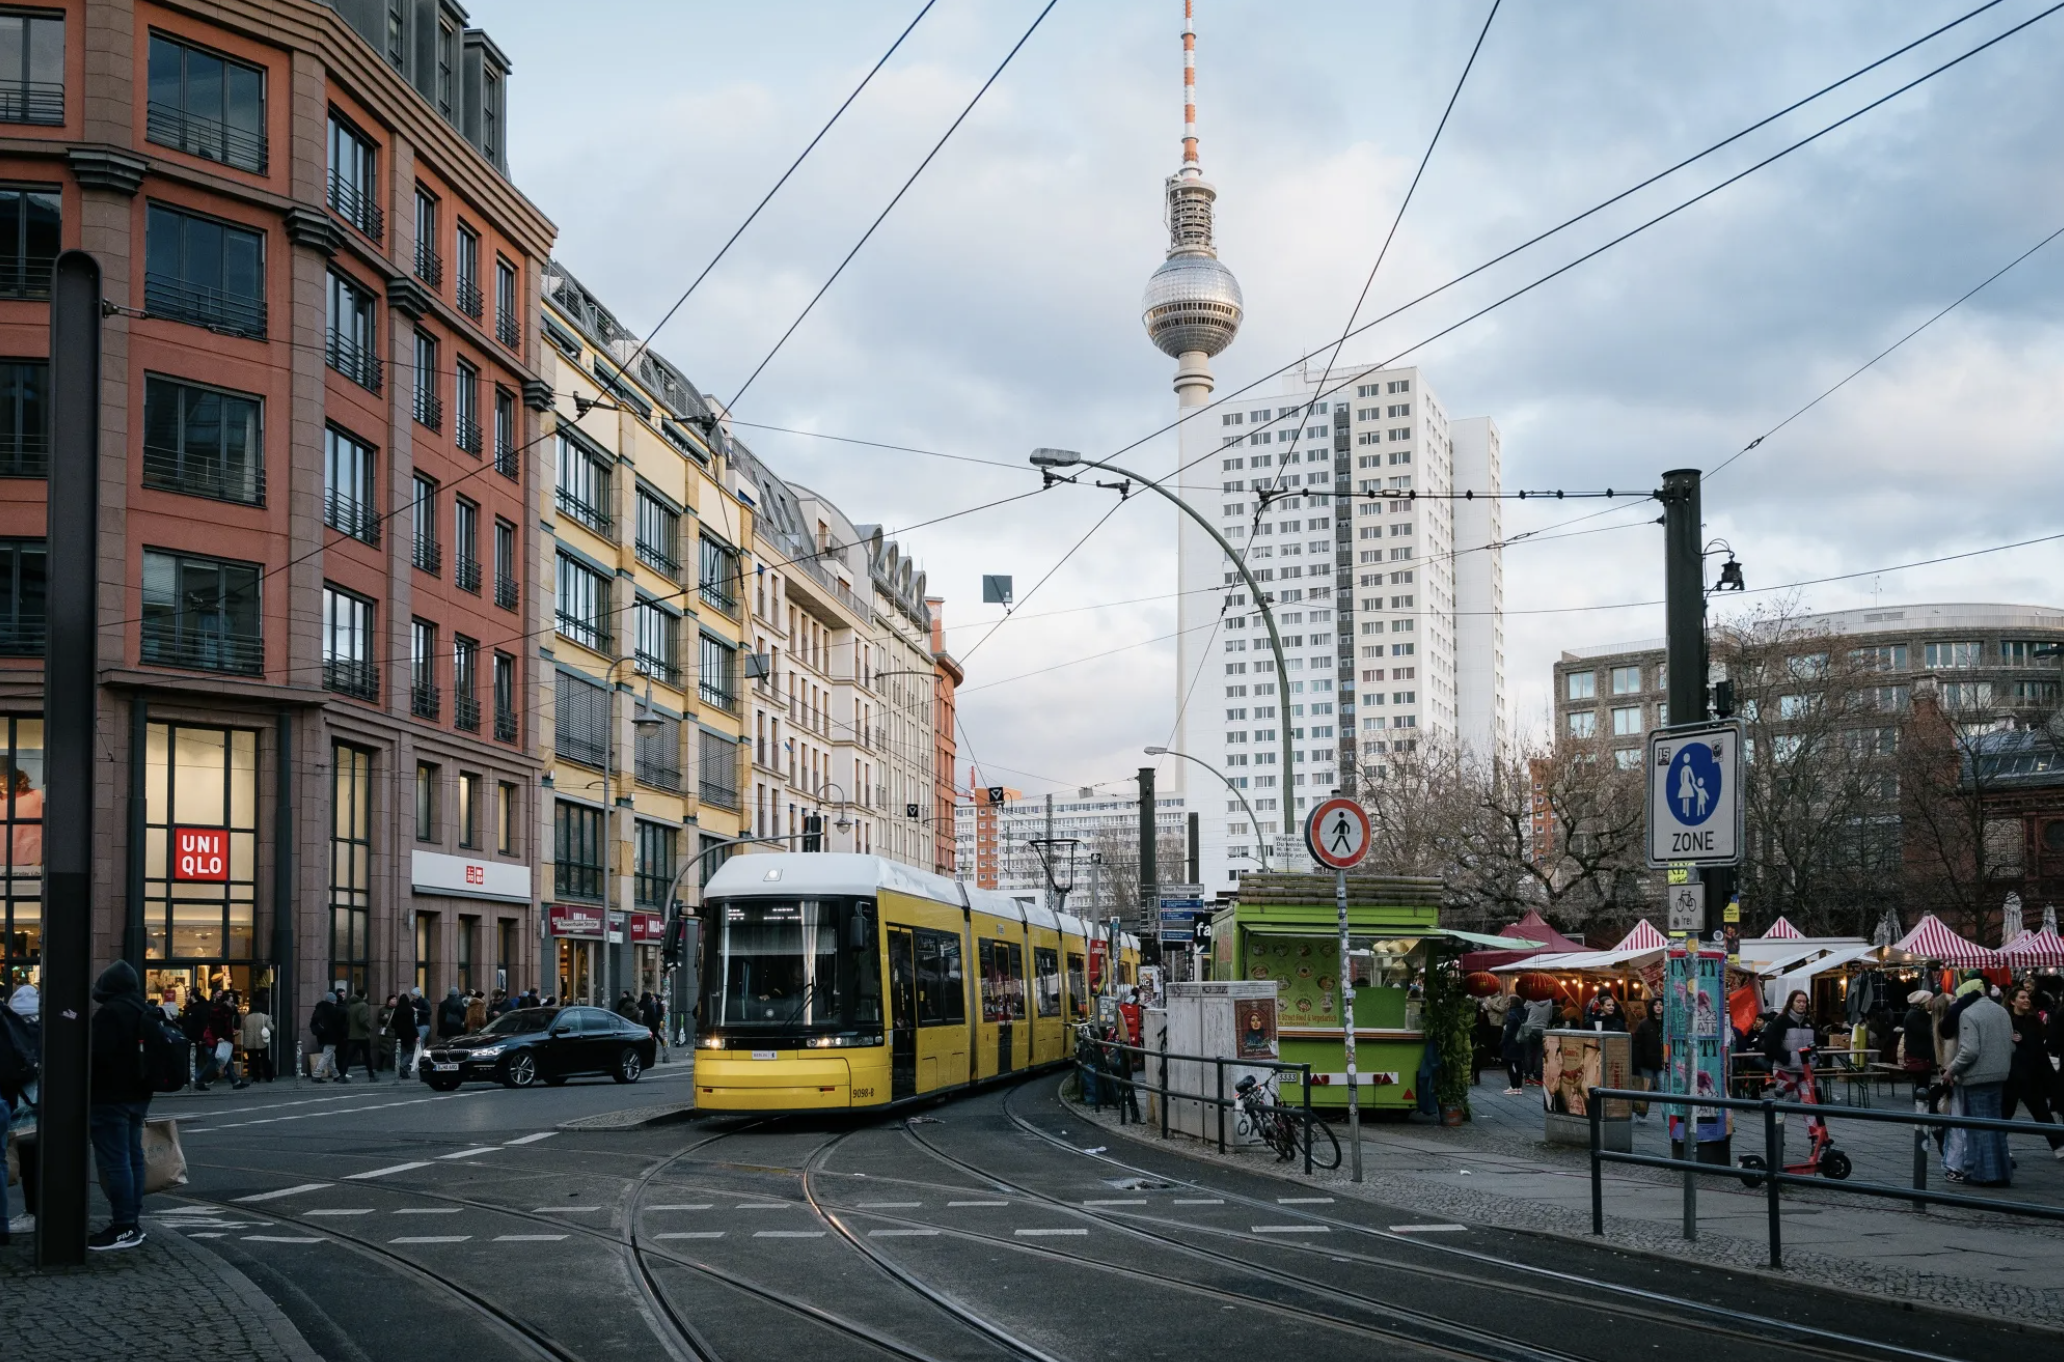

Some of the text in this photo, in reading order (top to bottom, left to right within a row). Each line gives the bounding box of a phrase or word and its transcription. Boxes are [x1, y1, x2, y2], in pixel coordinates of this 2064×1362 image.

[182, 834, 219, 854] UNI
[1672, 831, 1714, 852] ZONE
[182, 855, 222, 876] QLO
